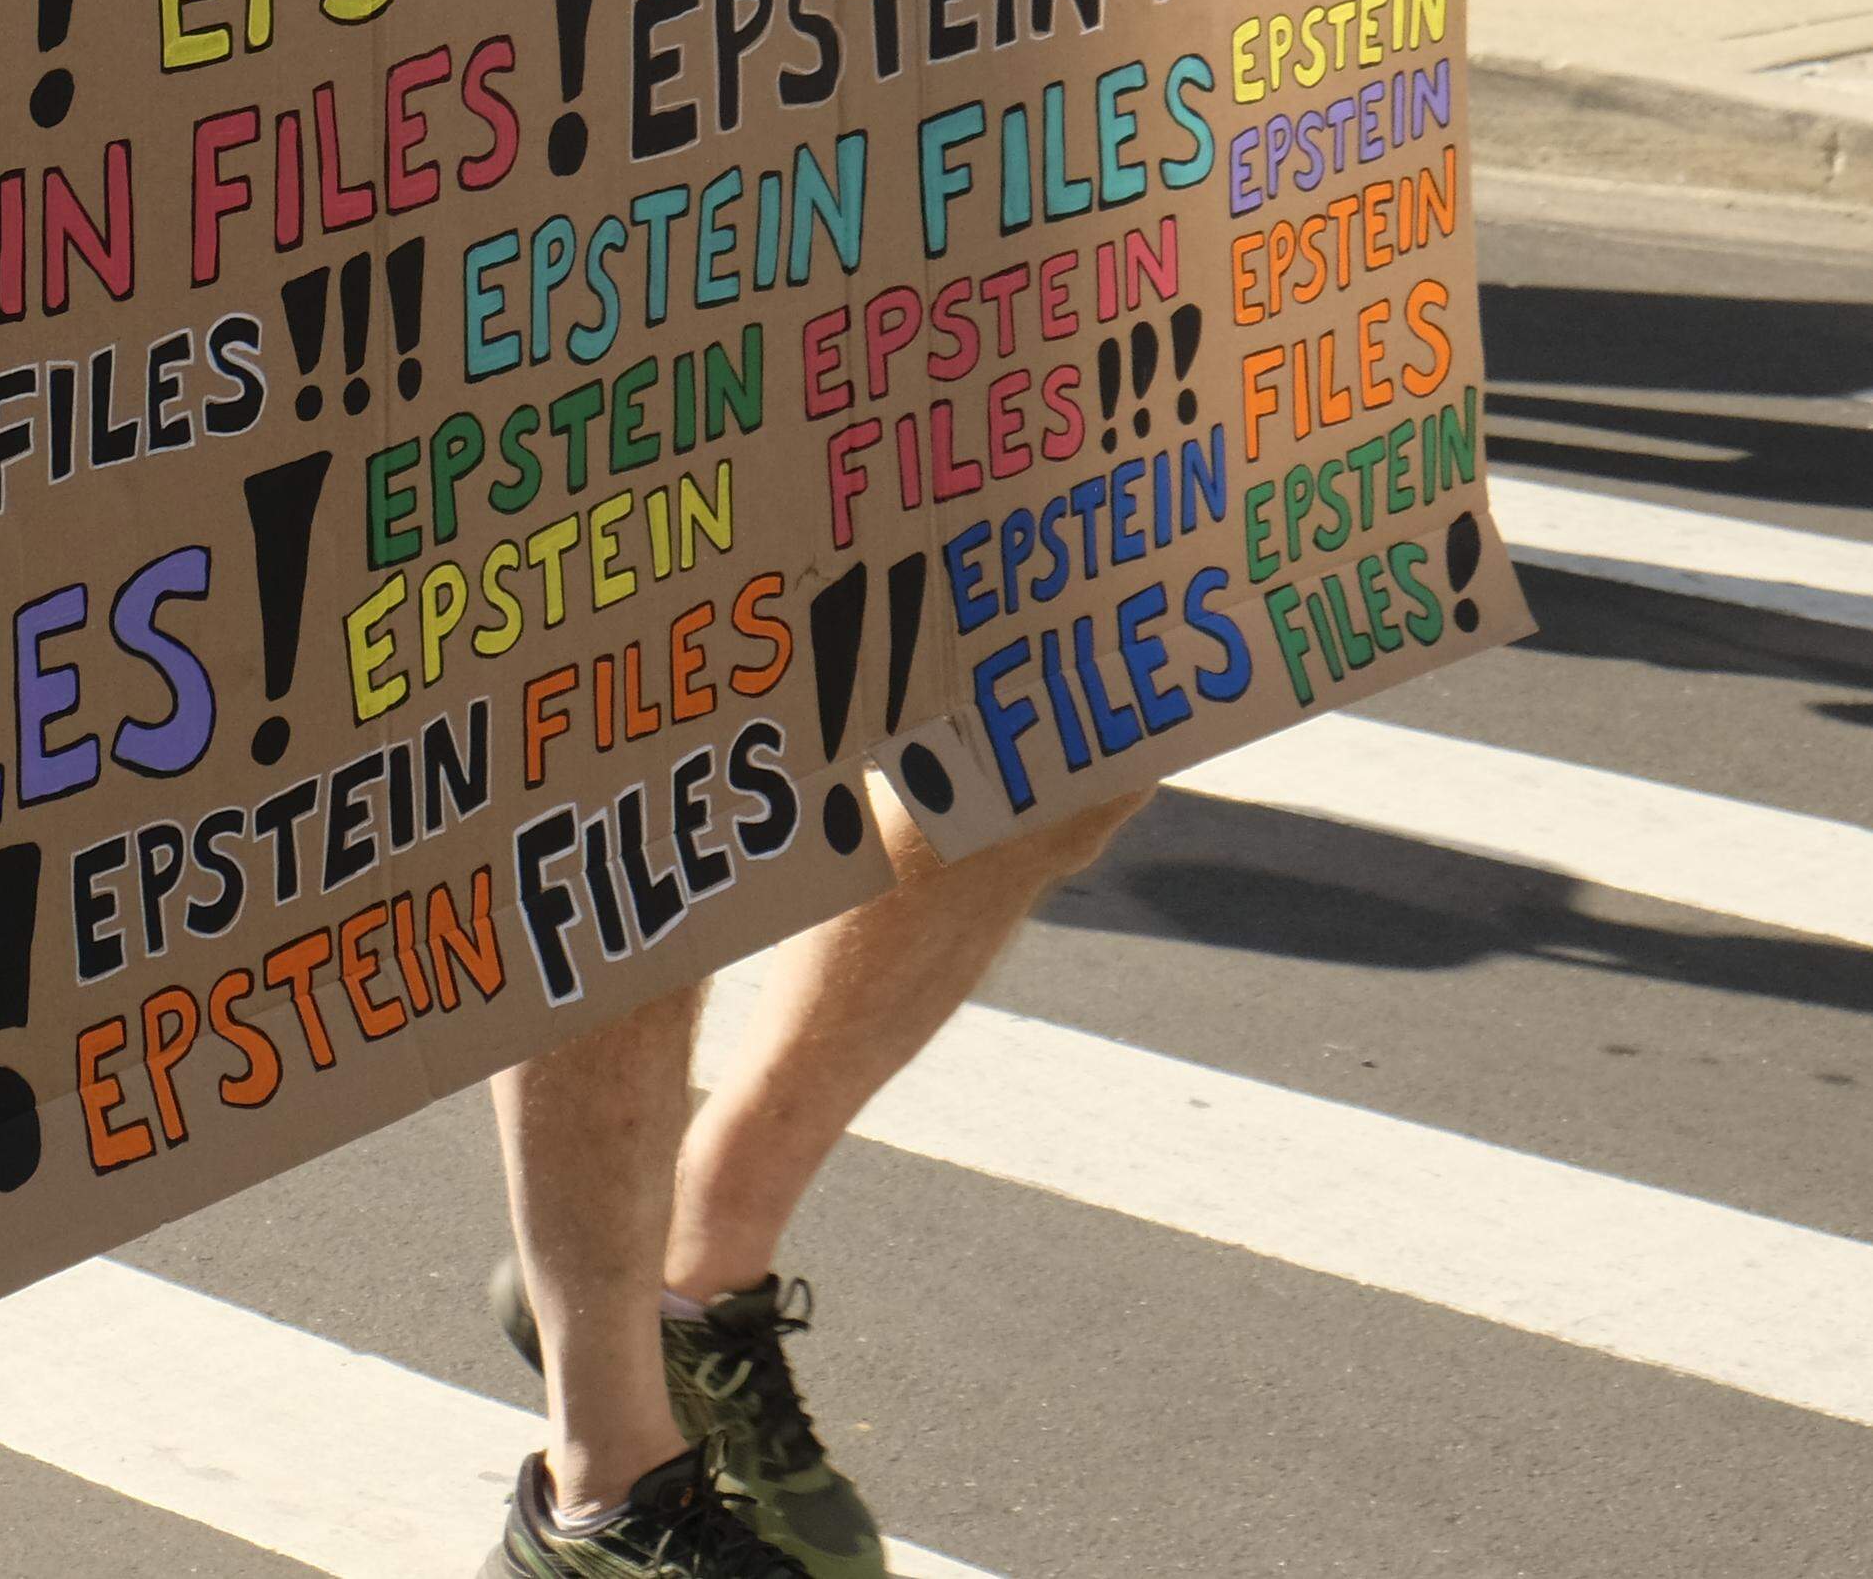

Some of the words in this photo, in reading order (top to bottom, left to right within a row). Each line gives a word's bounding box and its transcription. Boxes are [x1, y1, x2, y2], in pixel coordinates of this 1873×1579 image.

[461, 129, 868, 384] EPSTEIN
[918, 53, 1217, 258] FILES
[1228, 58, 1452, 217] EPSTEIN
[1229, 145, 1459, 327] EPSTEIN
[801, 215, 1179, 422] EPSTEIN
[1240, 279, 1452, 463] FILES
[365, 323, 764, 572] EPSTEIN
[943, 424, 1227, 636] EPSTEIN
[1243, 387, 1479, 585] EPSTEIN
[341, 458, 735, 727] EPSTEIN
[972, 565, 1255, 814] FILES
[1264, 511, 1482, 707] FILES!
[71, 695, 492, 986] EPSTEIN
[75, 863, 509, 1176] EPSTEIN
